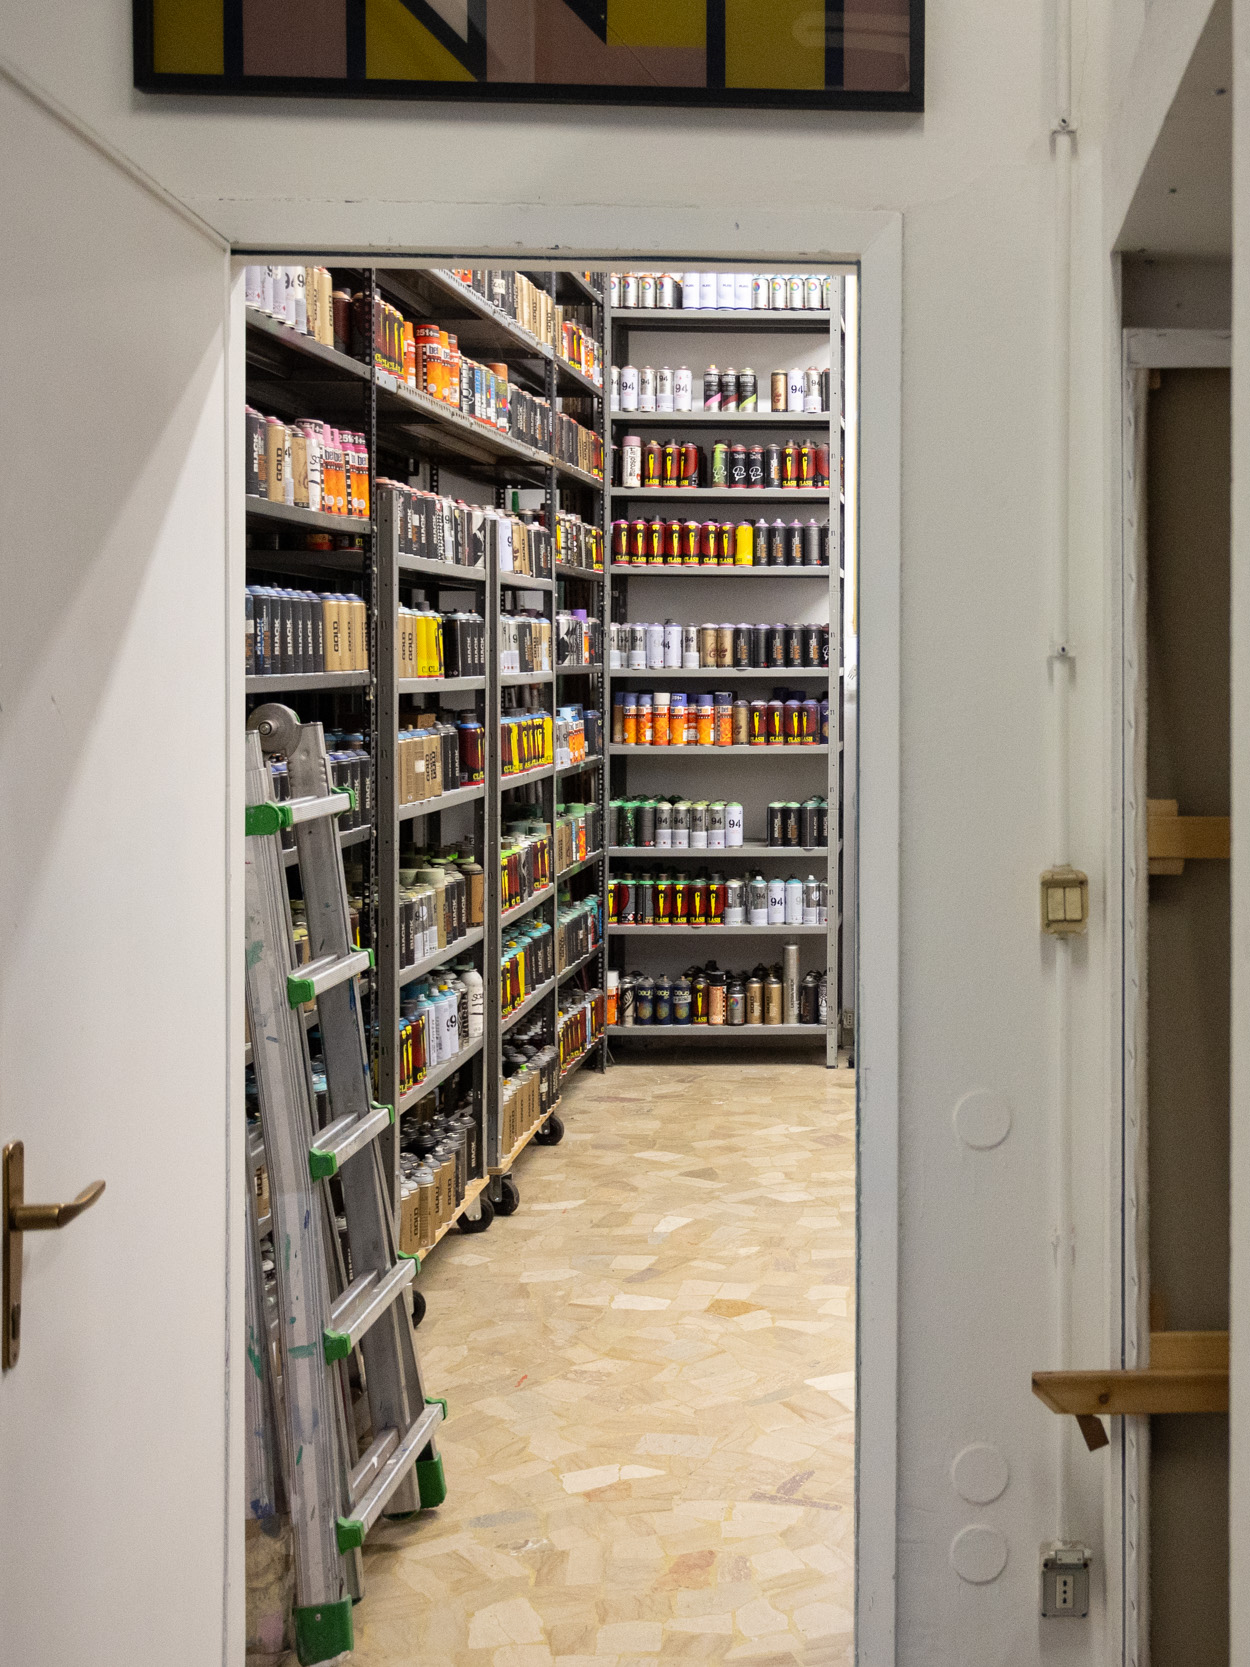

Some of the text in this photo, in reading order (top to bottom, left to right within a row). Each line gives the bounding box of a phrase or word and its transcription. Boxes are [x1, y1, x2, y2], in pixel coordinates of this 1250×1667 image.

[621, 381, 635, 391] 94
[791, 384, 804, 394] 94
[711, 817, 722, 826] 94
[728, 819, 741, 829] 94
[770, 897, 783, 907] 94
